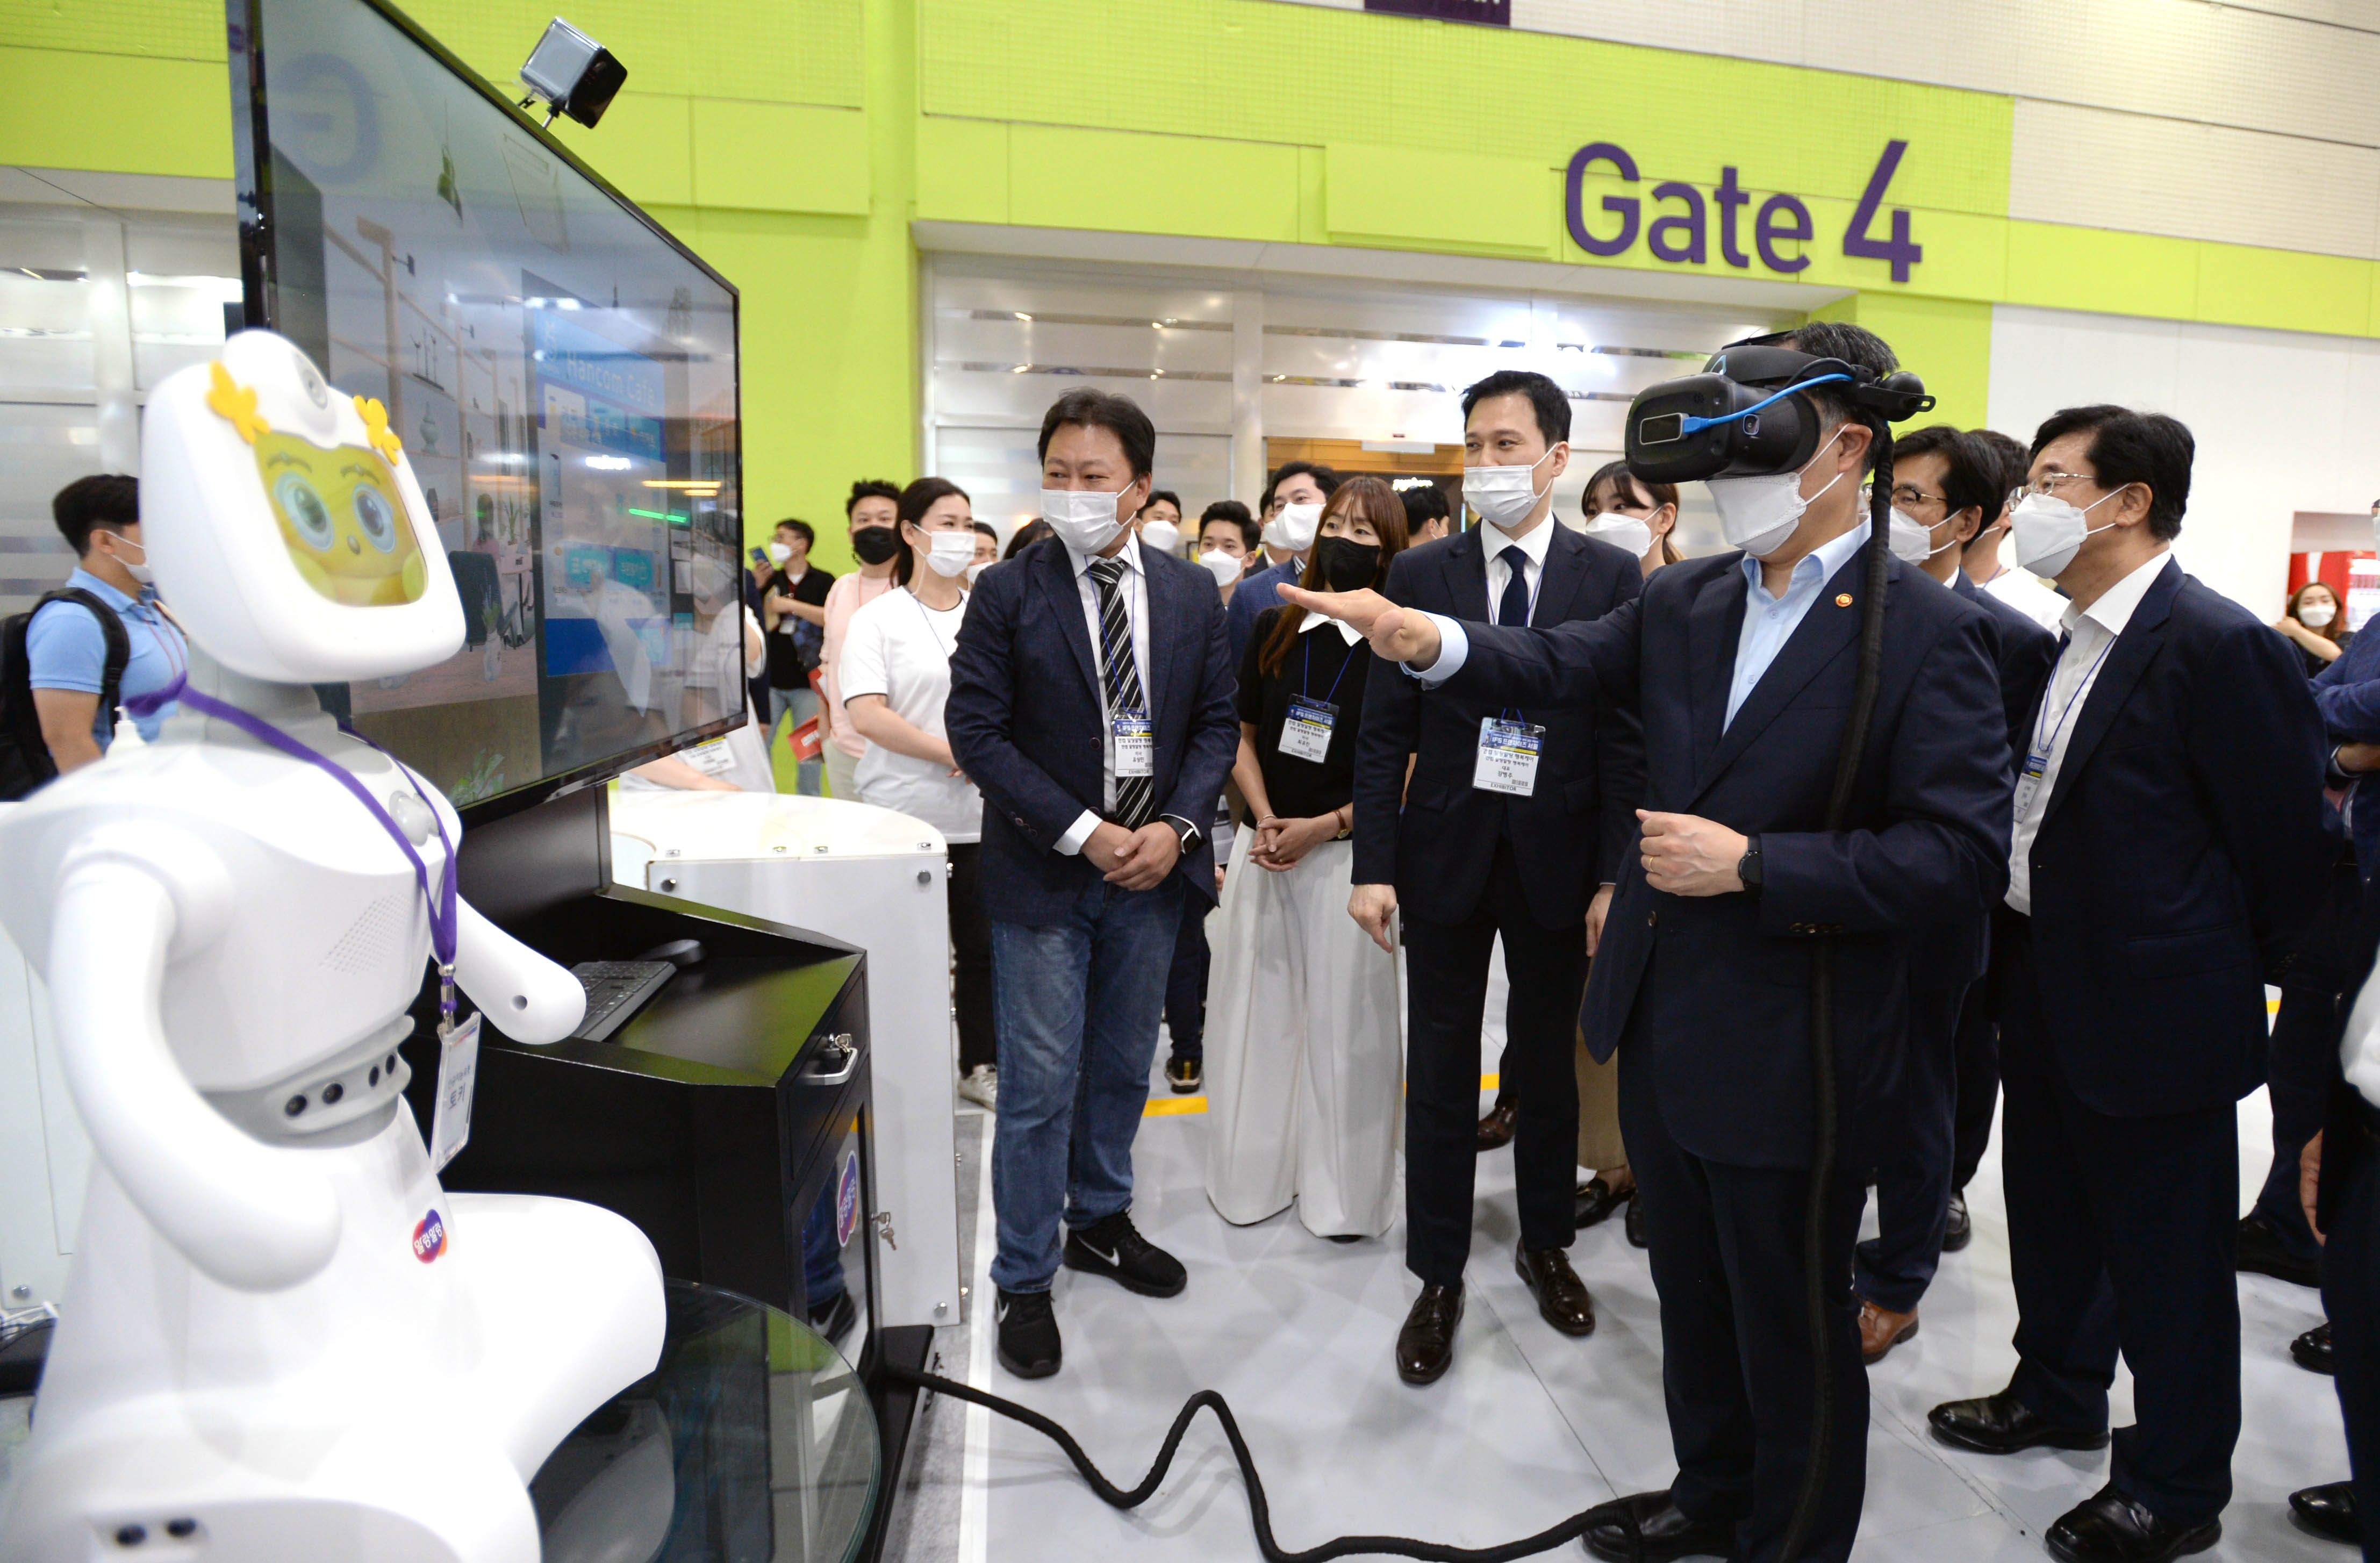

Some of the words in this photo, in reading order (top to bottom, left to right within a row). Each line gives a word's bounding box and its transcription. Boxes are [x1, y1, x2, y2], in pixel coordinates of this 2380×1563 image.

[1566, 142, 1813, 274] Gate
[1843, 139, 1923, 283] 4
[414, 1222, 442, 1255] 말랑말랑
